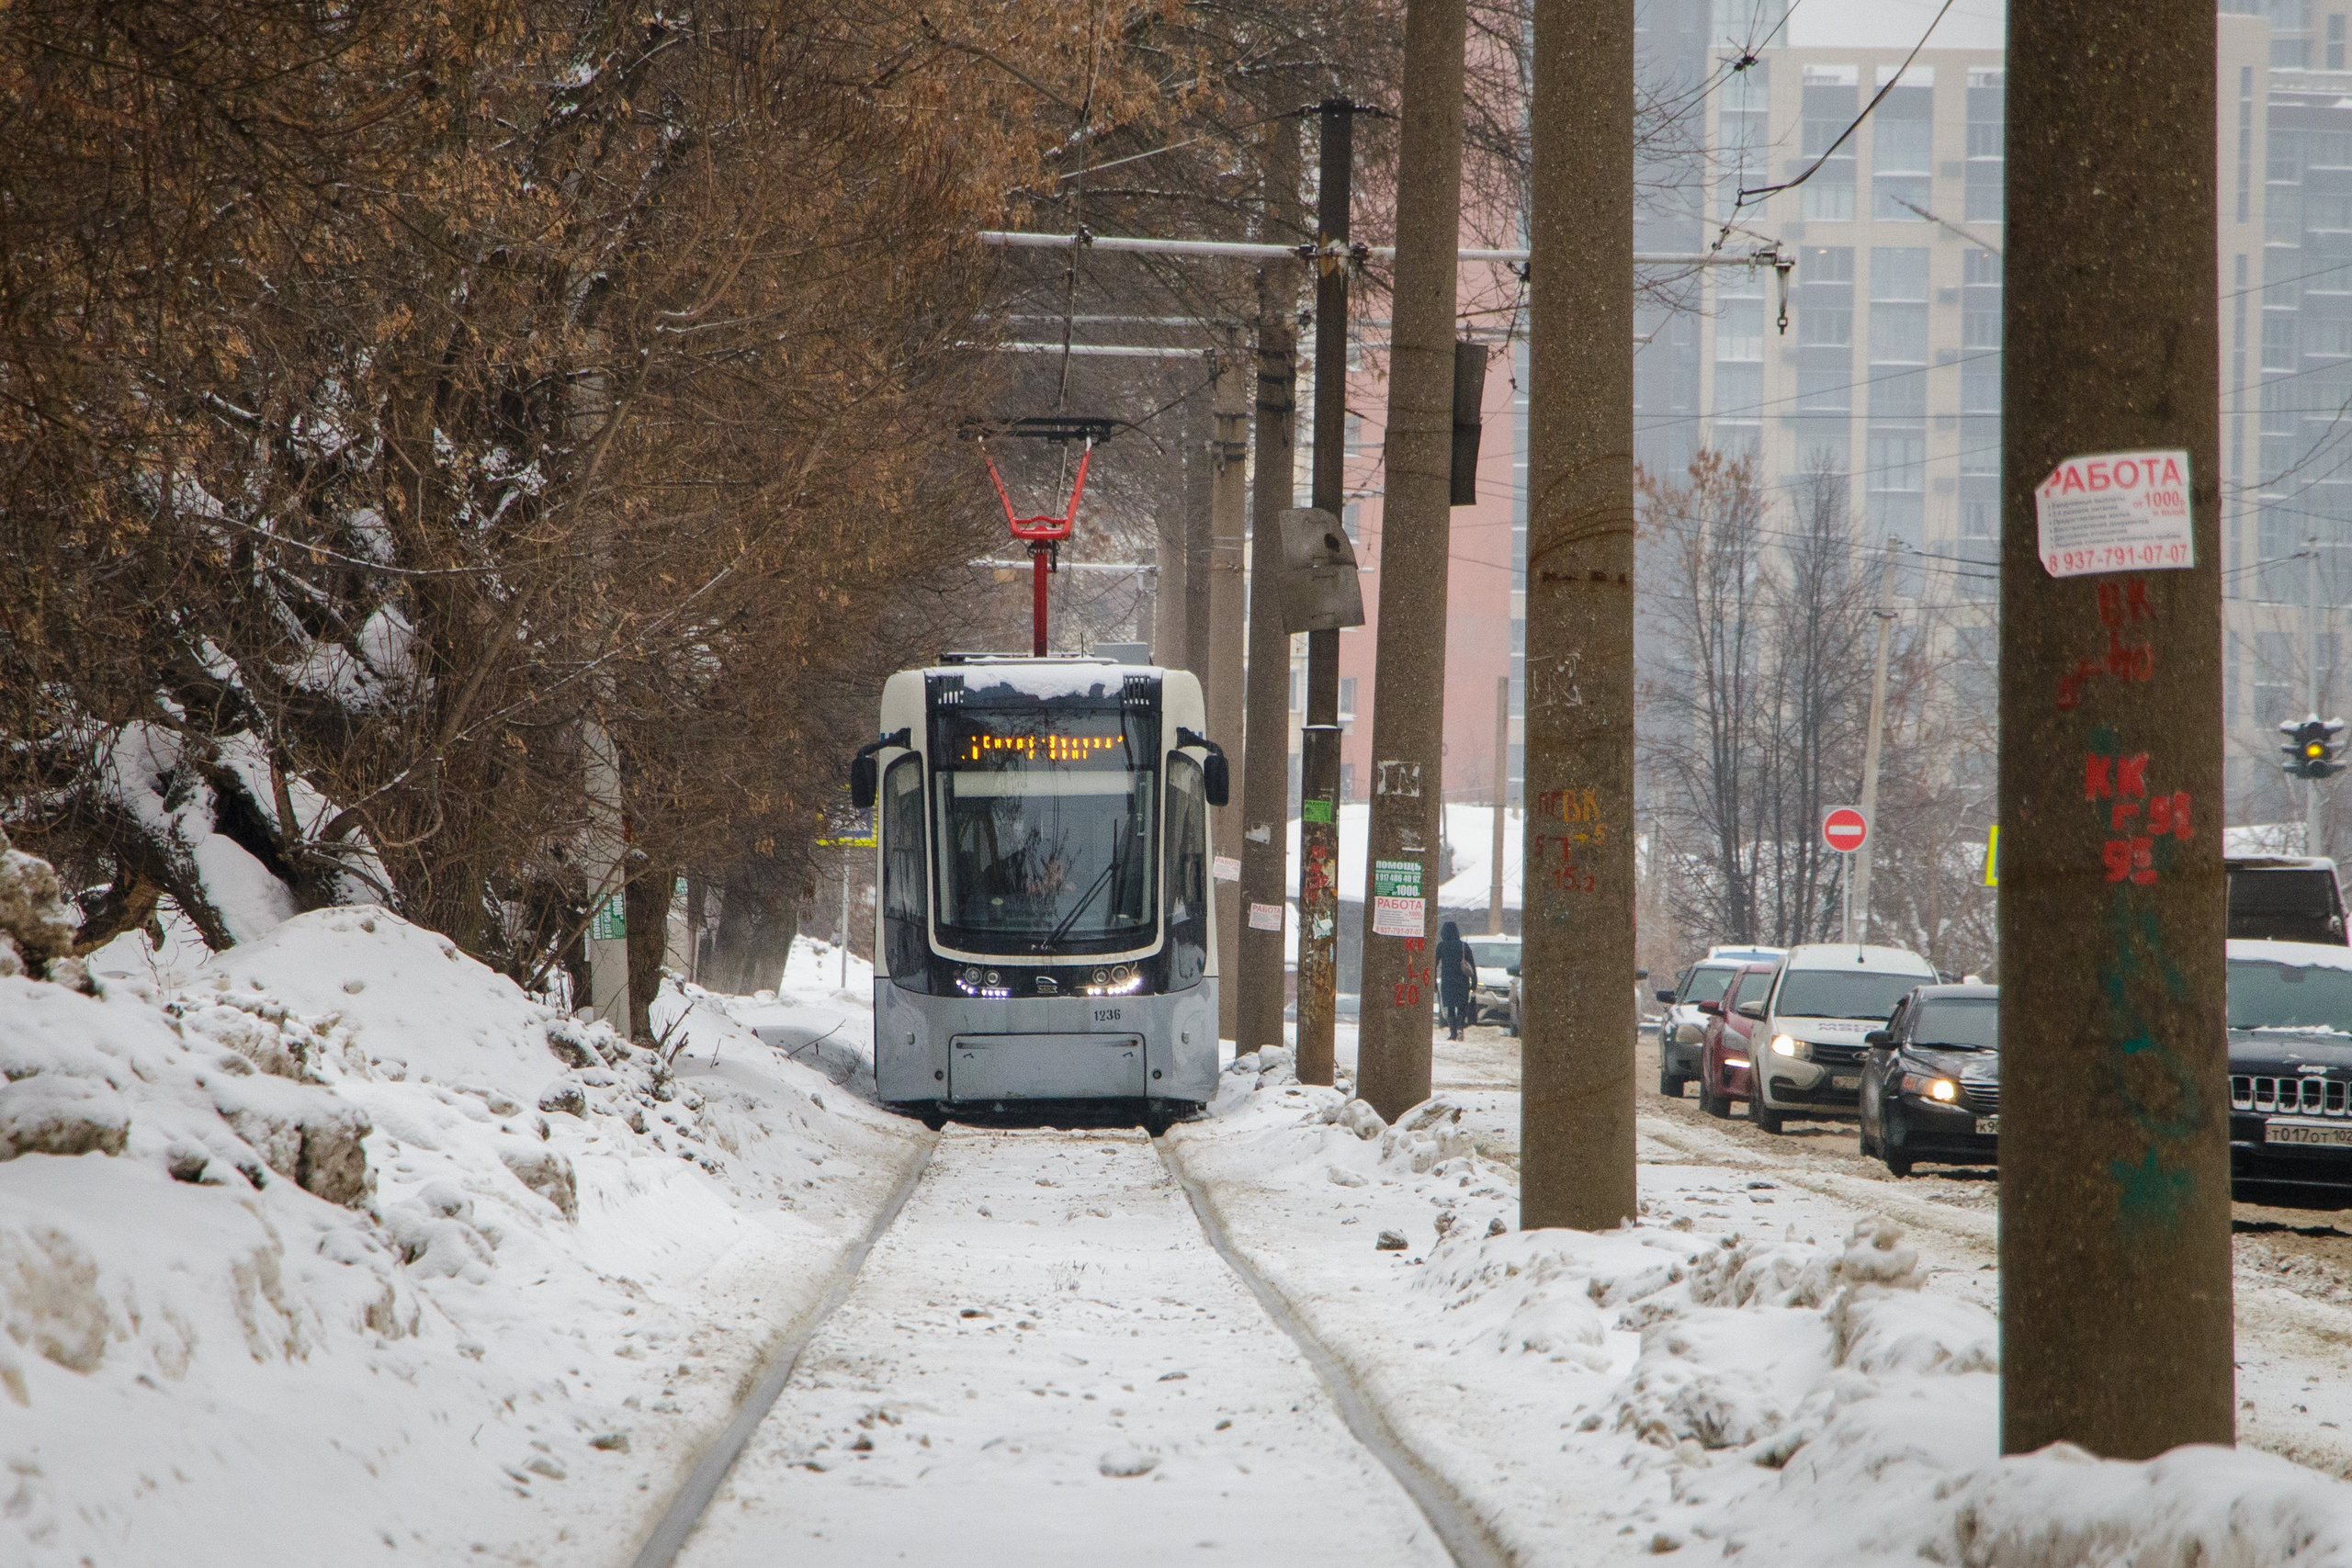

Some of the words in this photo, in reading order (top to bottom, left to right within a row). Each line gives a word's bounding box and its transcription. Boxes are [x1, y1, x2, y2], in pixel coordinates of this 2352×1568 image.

[2048, 553, 2059, 574] 8
[2064, 544, 2188, 570] 937-791-07-07
[1375, 860, 1421, 872] ПОМОЩЬ
[1252, 904, 1282, 915] РАБОТА
[1377, 897, 1422, 910] РАБОТА
[1394, 983, 1419, 1008] 20
[1093, 1009, 1121, 1021] 1236
